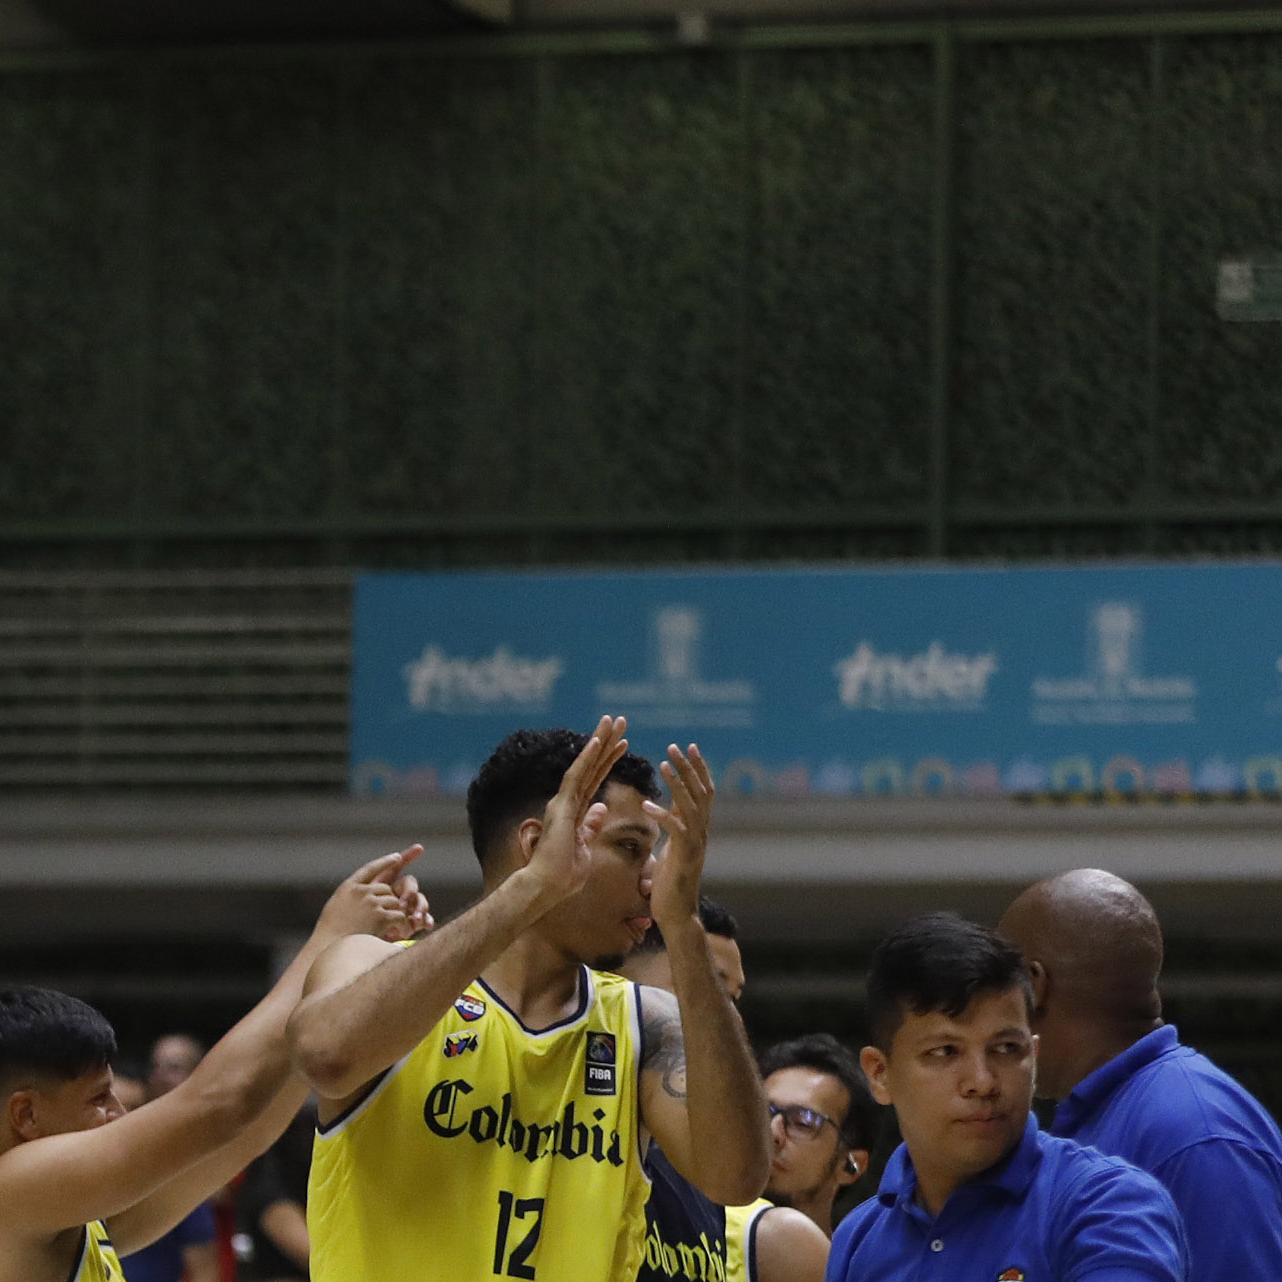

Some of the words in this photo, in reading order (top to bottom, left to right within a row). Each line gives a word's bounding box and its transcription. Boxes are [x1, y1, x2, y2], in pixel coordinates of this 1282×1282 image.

[455, 999, 485, 1014] FCB
[589, 1067, 611, 1081] FIBA
[423, 1079, 624, 1167] Colombia
[492, 1190, 545, 1281] 12
